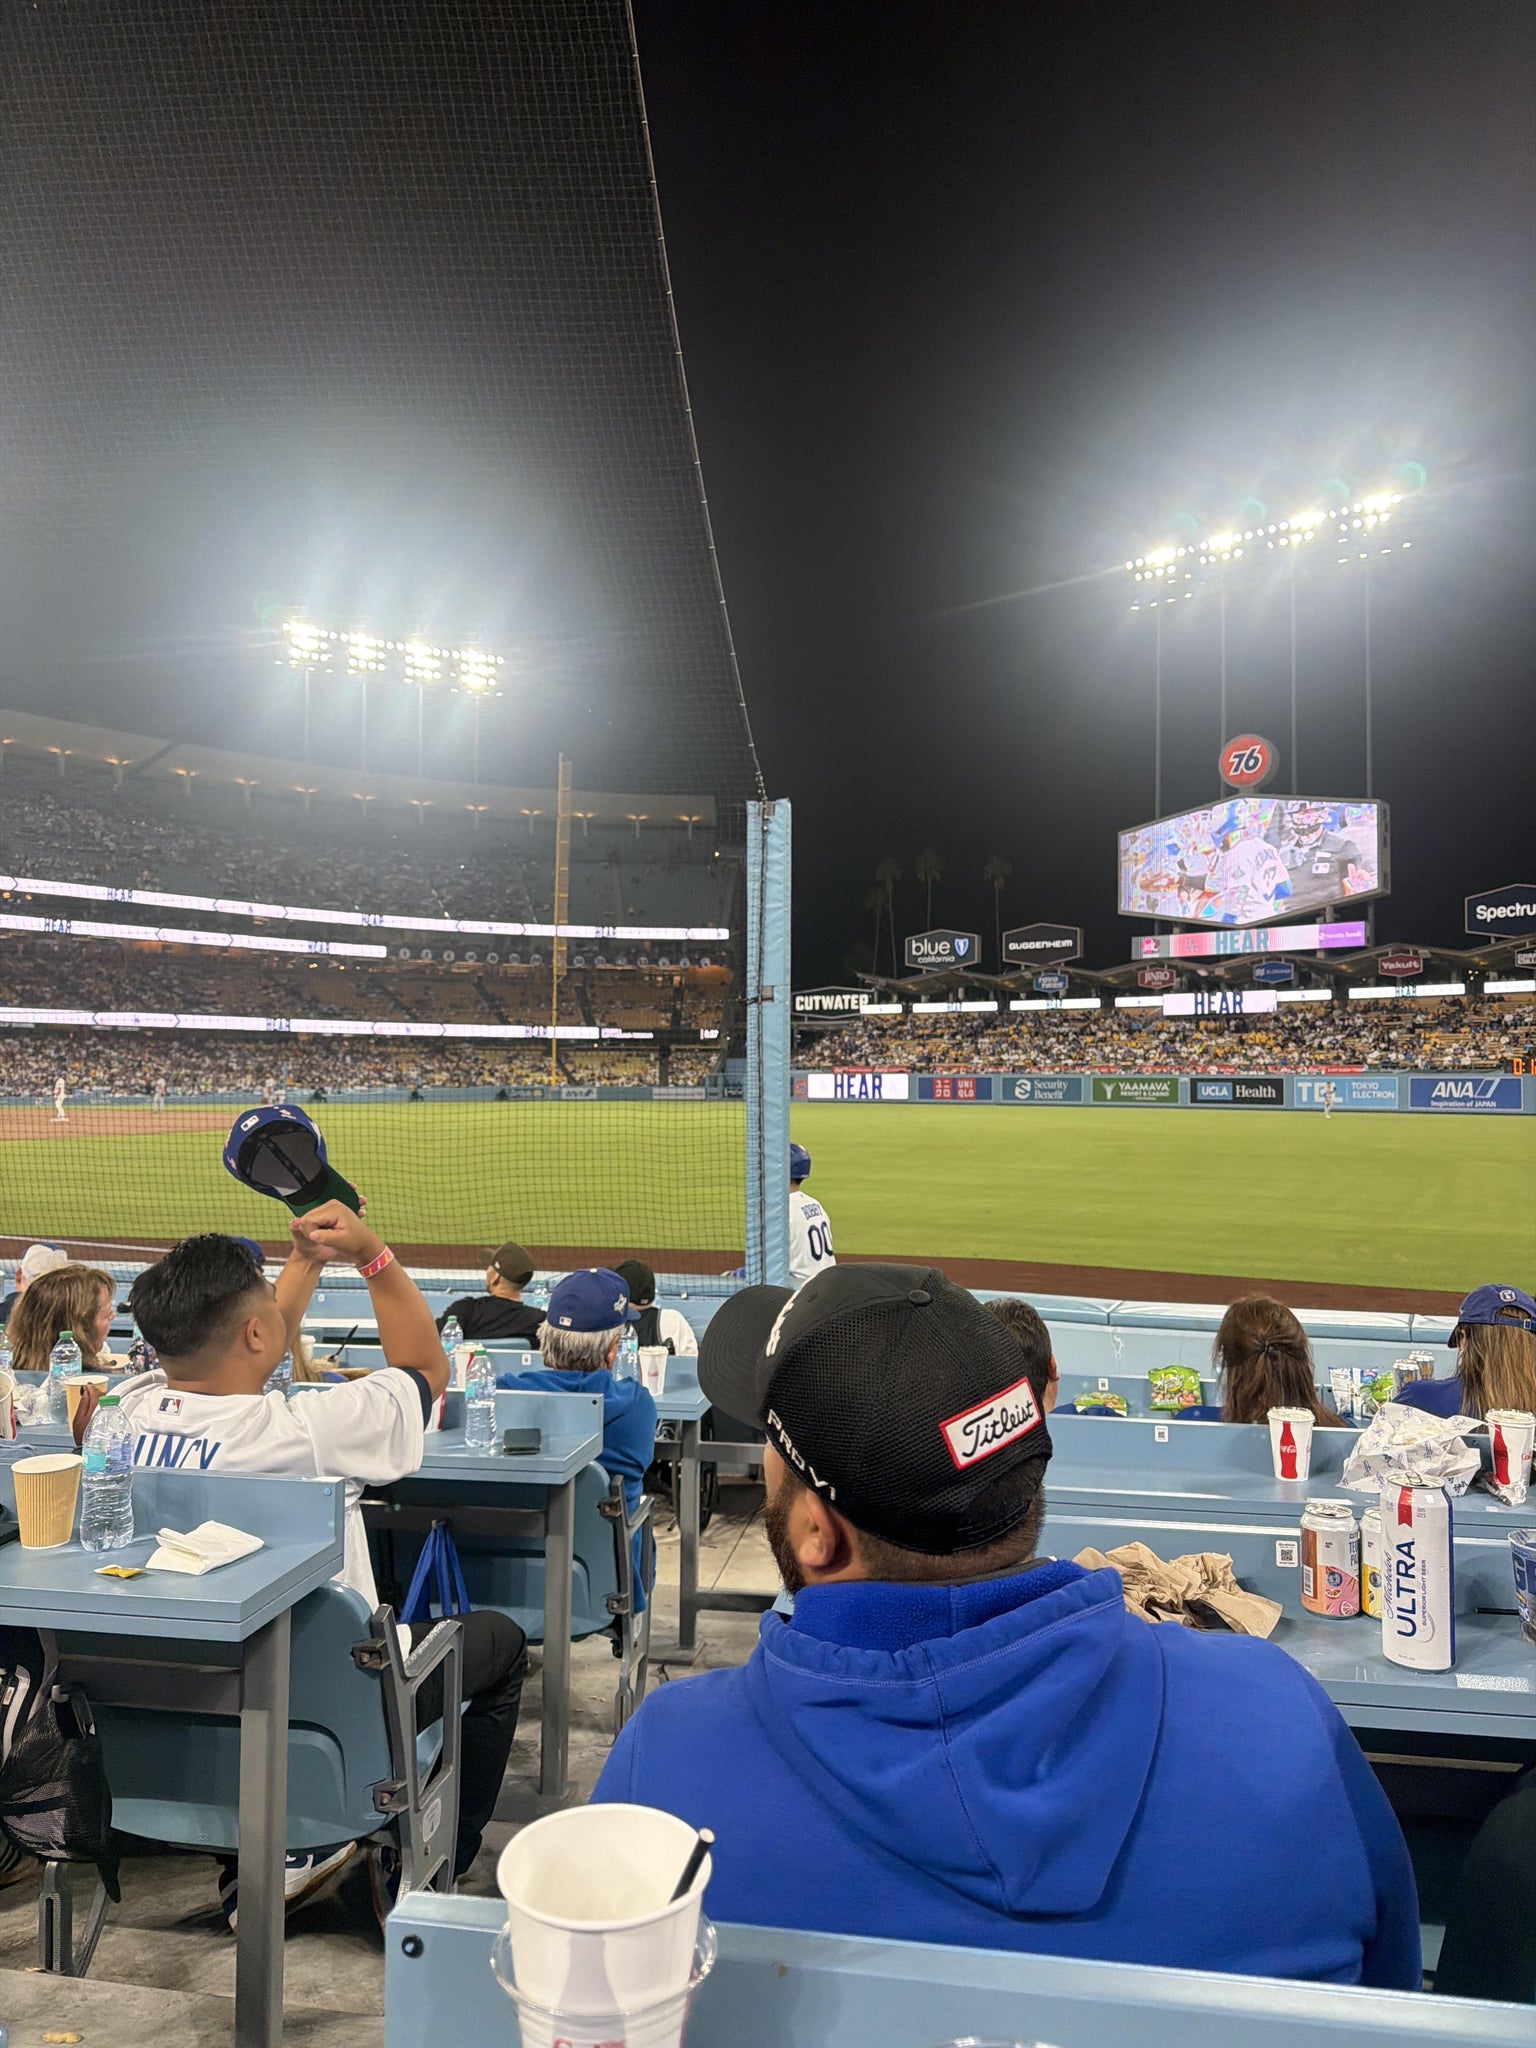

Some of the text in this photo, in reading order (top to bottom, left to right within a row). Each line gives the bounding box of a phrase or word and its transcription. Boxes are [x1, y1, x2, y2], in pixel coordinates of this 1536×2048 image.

[1229, 745, 1262, 776] 76
[912, 939, 951, 955] blue
[1008, 939, 1073, 950] GUGGENHEIM
[1215, 928, 1269, 954] HEAR
[917, 955, 955, 963] california
[1381, 960, 1421, 969] Yakult
[1144, 971, 1170, 984] JINRO
[795, 993, 869, 1011] CUTWATER
[1194, 991, 1244, 1015] HEAR
[1513, 1058, 1536, 1076] 0:1
[834, 1073, 883, 1099] HEAR
[958, 1080, 974, 1088] UNI
[1034, 1080, 1068, 1092] Security
[1201, 1085, 1276, 1098] UCLA Health
[1431, 1081, 1474, 1098] ANA
[958, 1089, 975, 1097] QLO
[1034, 1090, 1064, 1099] Benefit
[1352, 1091, 1395, 1099] ELECTRON
[962, 1400, 1034, 1458] Titleist
[767, 1409, 806, 1471] PRO
[133, 1434, 222, 1470] UNCY
[1396, 1541, 1417, 1638] ULTRA
